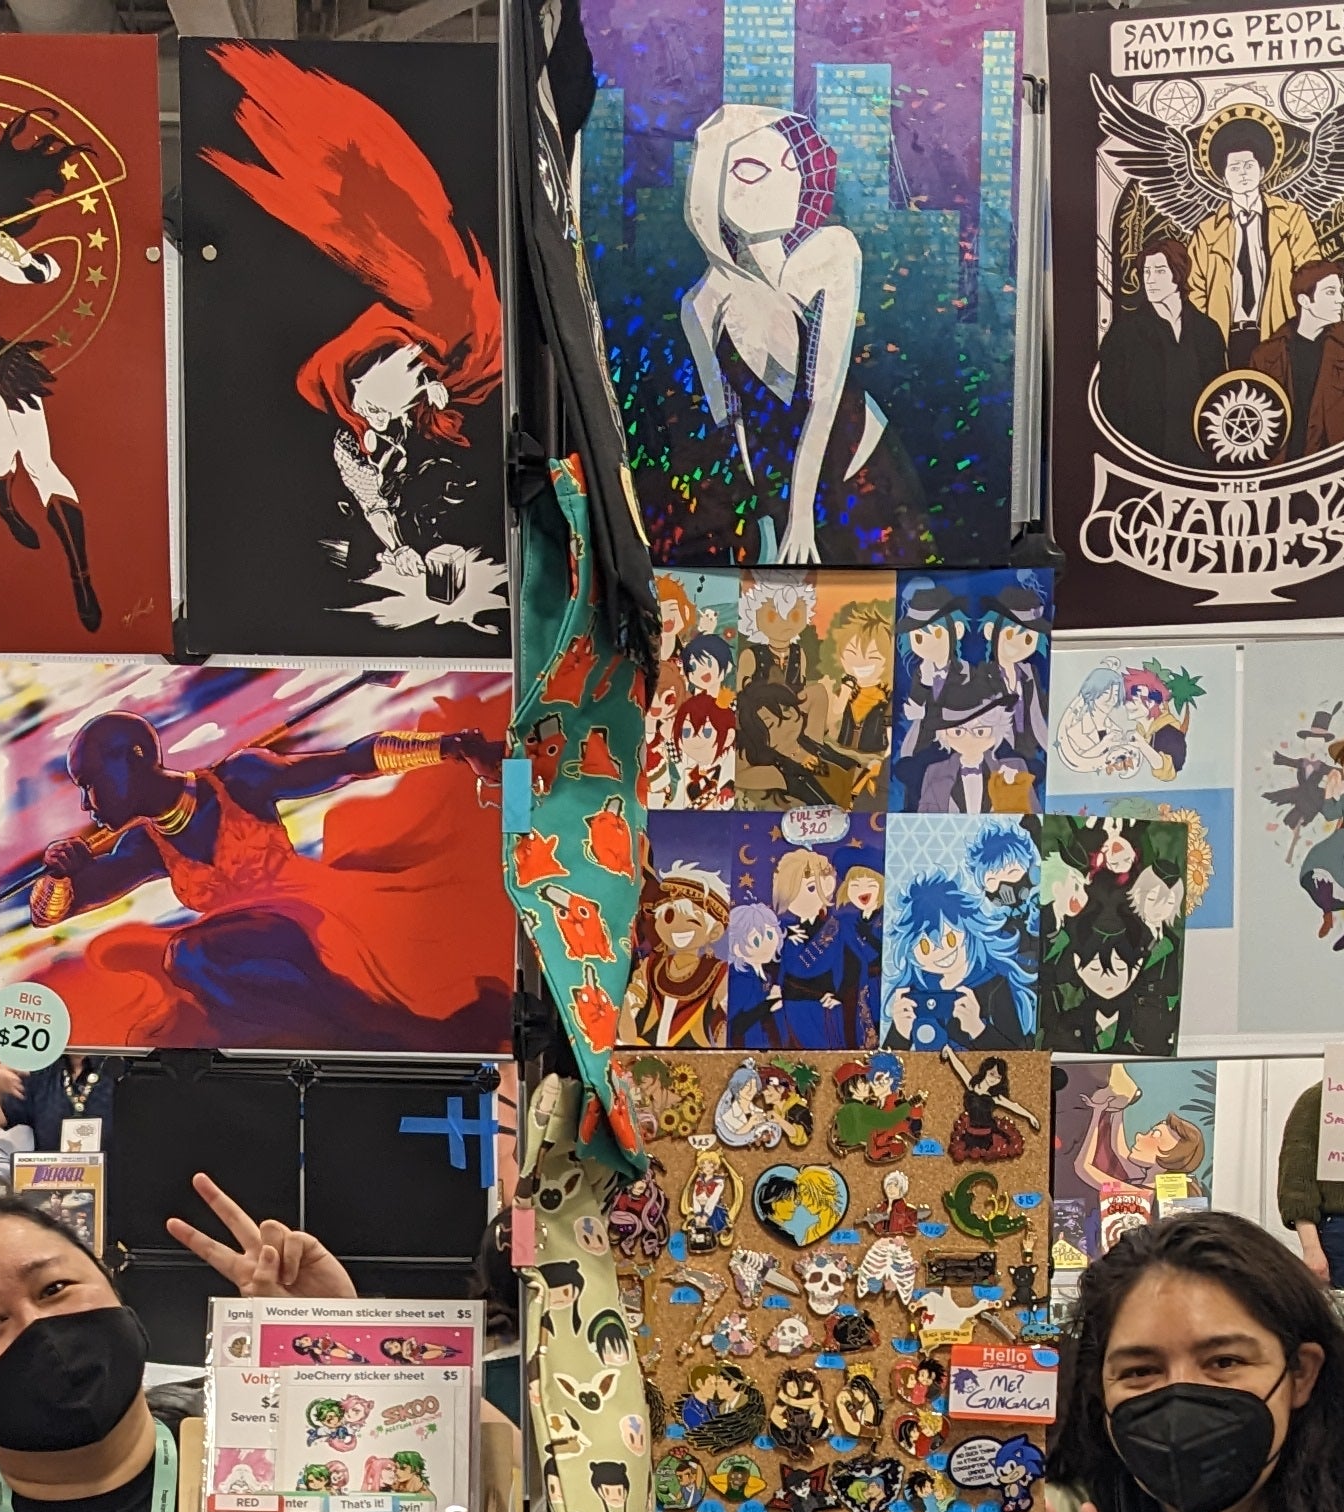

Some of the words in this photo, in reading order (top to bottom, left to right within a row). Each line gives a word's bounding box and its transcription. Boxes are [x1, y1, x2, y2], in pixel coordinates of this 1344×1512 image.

[1123, 18, 1233, 48] SAVING
[1124, 44, 1235, 71] HUNTING
[1220, 480, 1257, 494] THE
[789, 810, 812, 823] FULL
[814, 809, 833, 820] SET
[798, 821, 827, 837] $20
[19, 992, 42, 1006] BIG
[4, 1006, 51, 1025] PRINTS
[266, 1307, 309, 1318] Wonder
[312, 1308, 353, 1318] Woman
[355, 1308, 392, 1318] sticker
[395, 1308, 426, 1319] sheet
[427, 1310, 445, 1319] set
[457, 1308, 472, 1319] $5
[983, 1347, 1027, 1363] Hello
[293, 1371, 351, 1383] JoeCherry
[354, 1371, 391, 1381] sticker
[394, 1371, 424, 1381] sheet
[443, 1371, 458, 1382] $5
[966, 1390, 1050, 1411] GONGAGA
[231, 1413, 266, 1423] Seven
[236, 1498, 259, 1508] RED
[341, 1499, 371, 1509] That's
